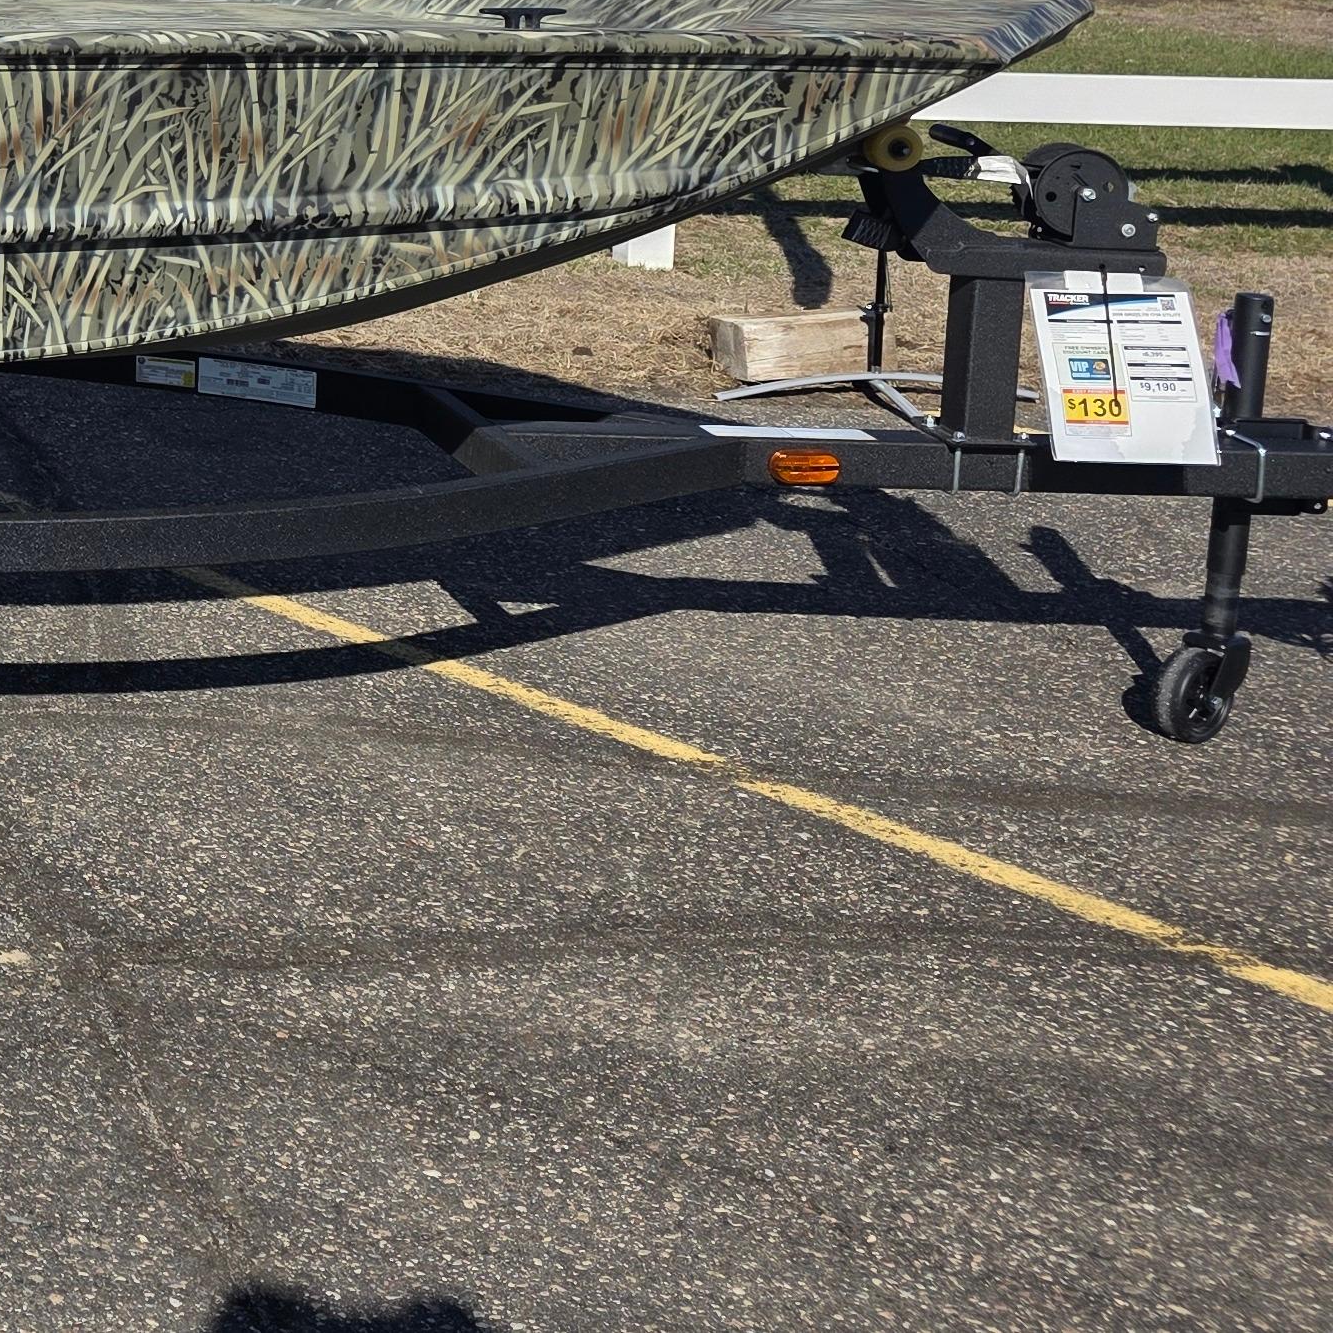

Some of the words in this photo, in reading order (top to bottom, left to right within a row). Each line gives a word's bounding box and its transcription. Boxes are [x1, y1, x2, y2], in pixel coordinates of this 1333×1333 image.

[1047, 293, 1089, 302] TRACKER
[1069, 361, 1089, 372] VIP
[1140, 382, 1176, 392] $9,190
[1067, 398, 1122, 417] $130
